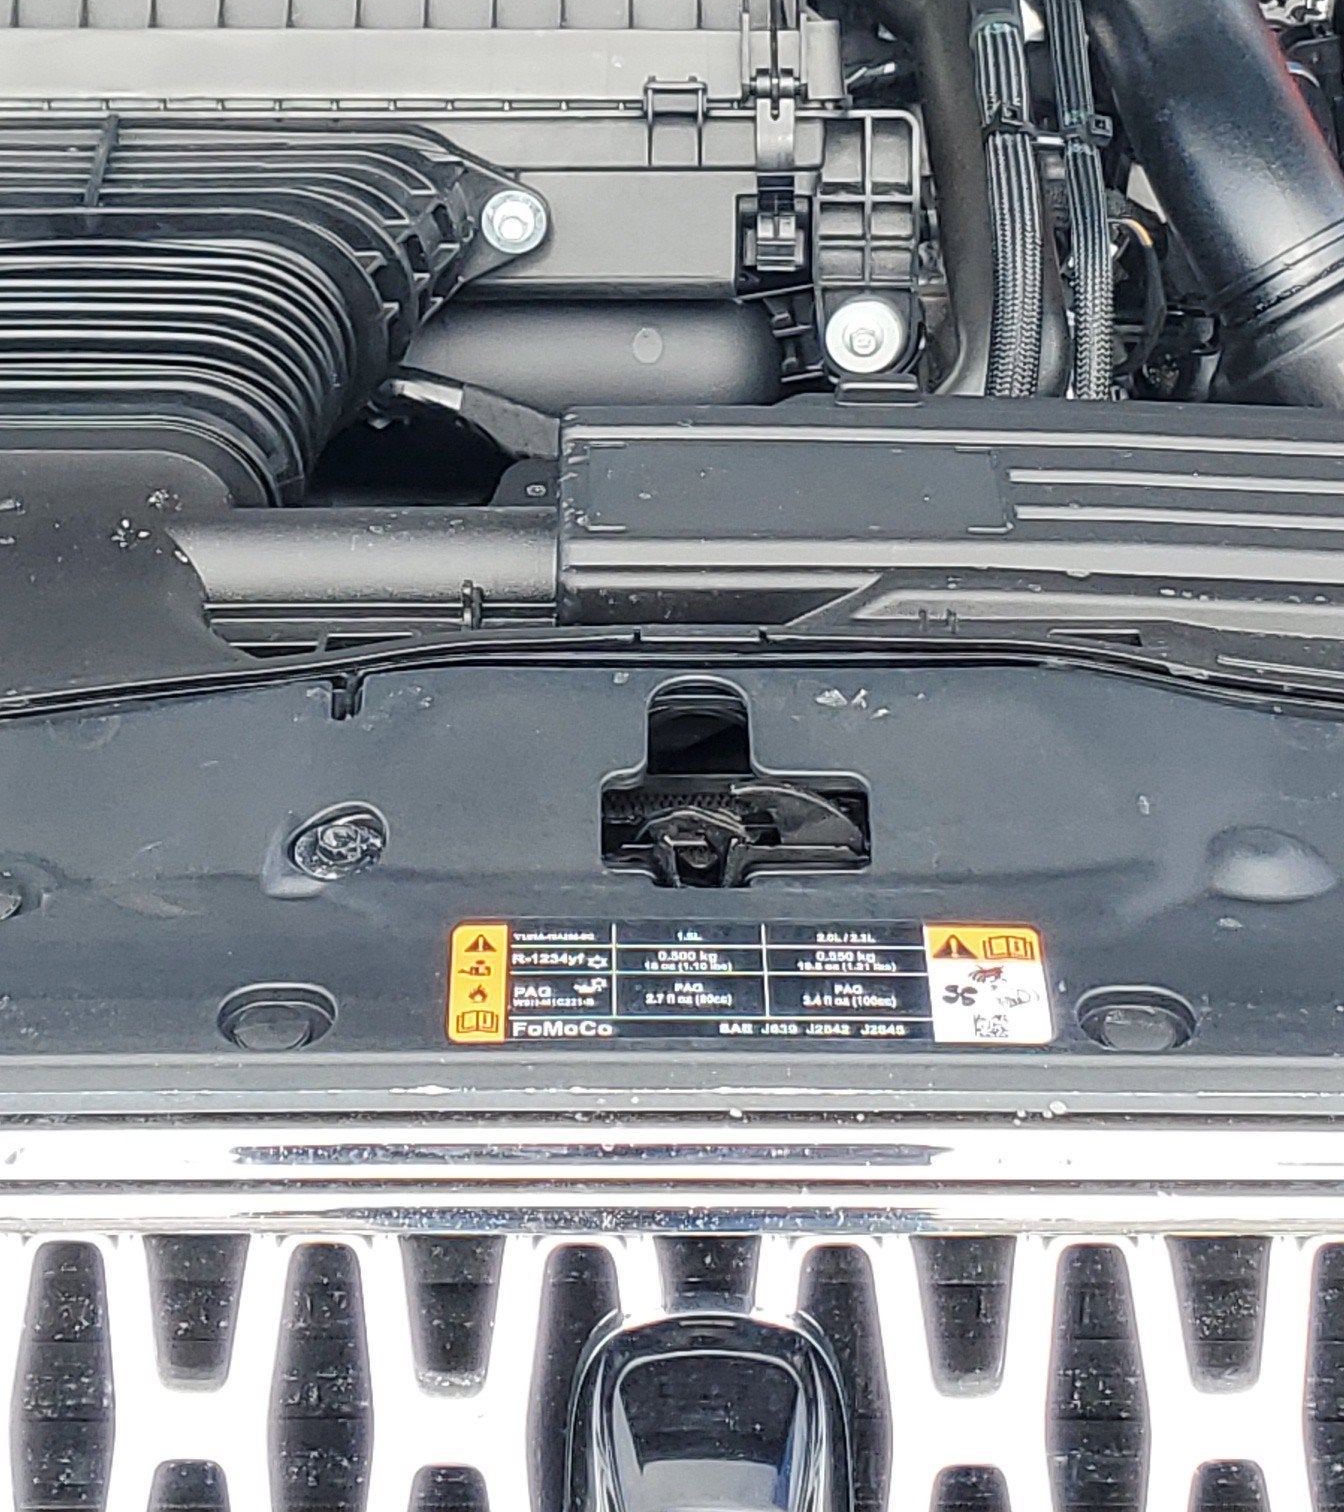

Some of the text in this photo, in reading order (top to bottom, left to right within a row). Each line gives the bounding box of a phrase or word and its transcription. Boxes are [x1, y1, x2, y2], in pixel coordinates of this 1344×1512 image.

[512, 952, 586, 966] R-1234yf
[657, 950, 718, 963] 0.500 kg
[856, 951, 876, 963] kg
[513, 986, 552, 998] PAG
[674, 982, 704, 993] PAG
[834, 984, 863, 995] PAG
[512, 1020, 613, 1037] FoMoCo
